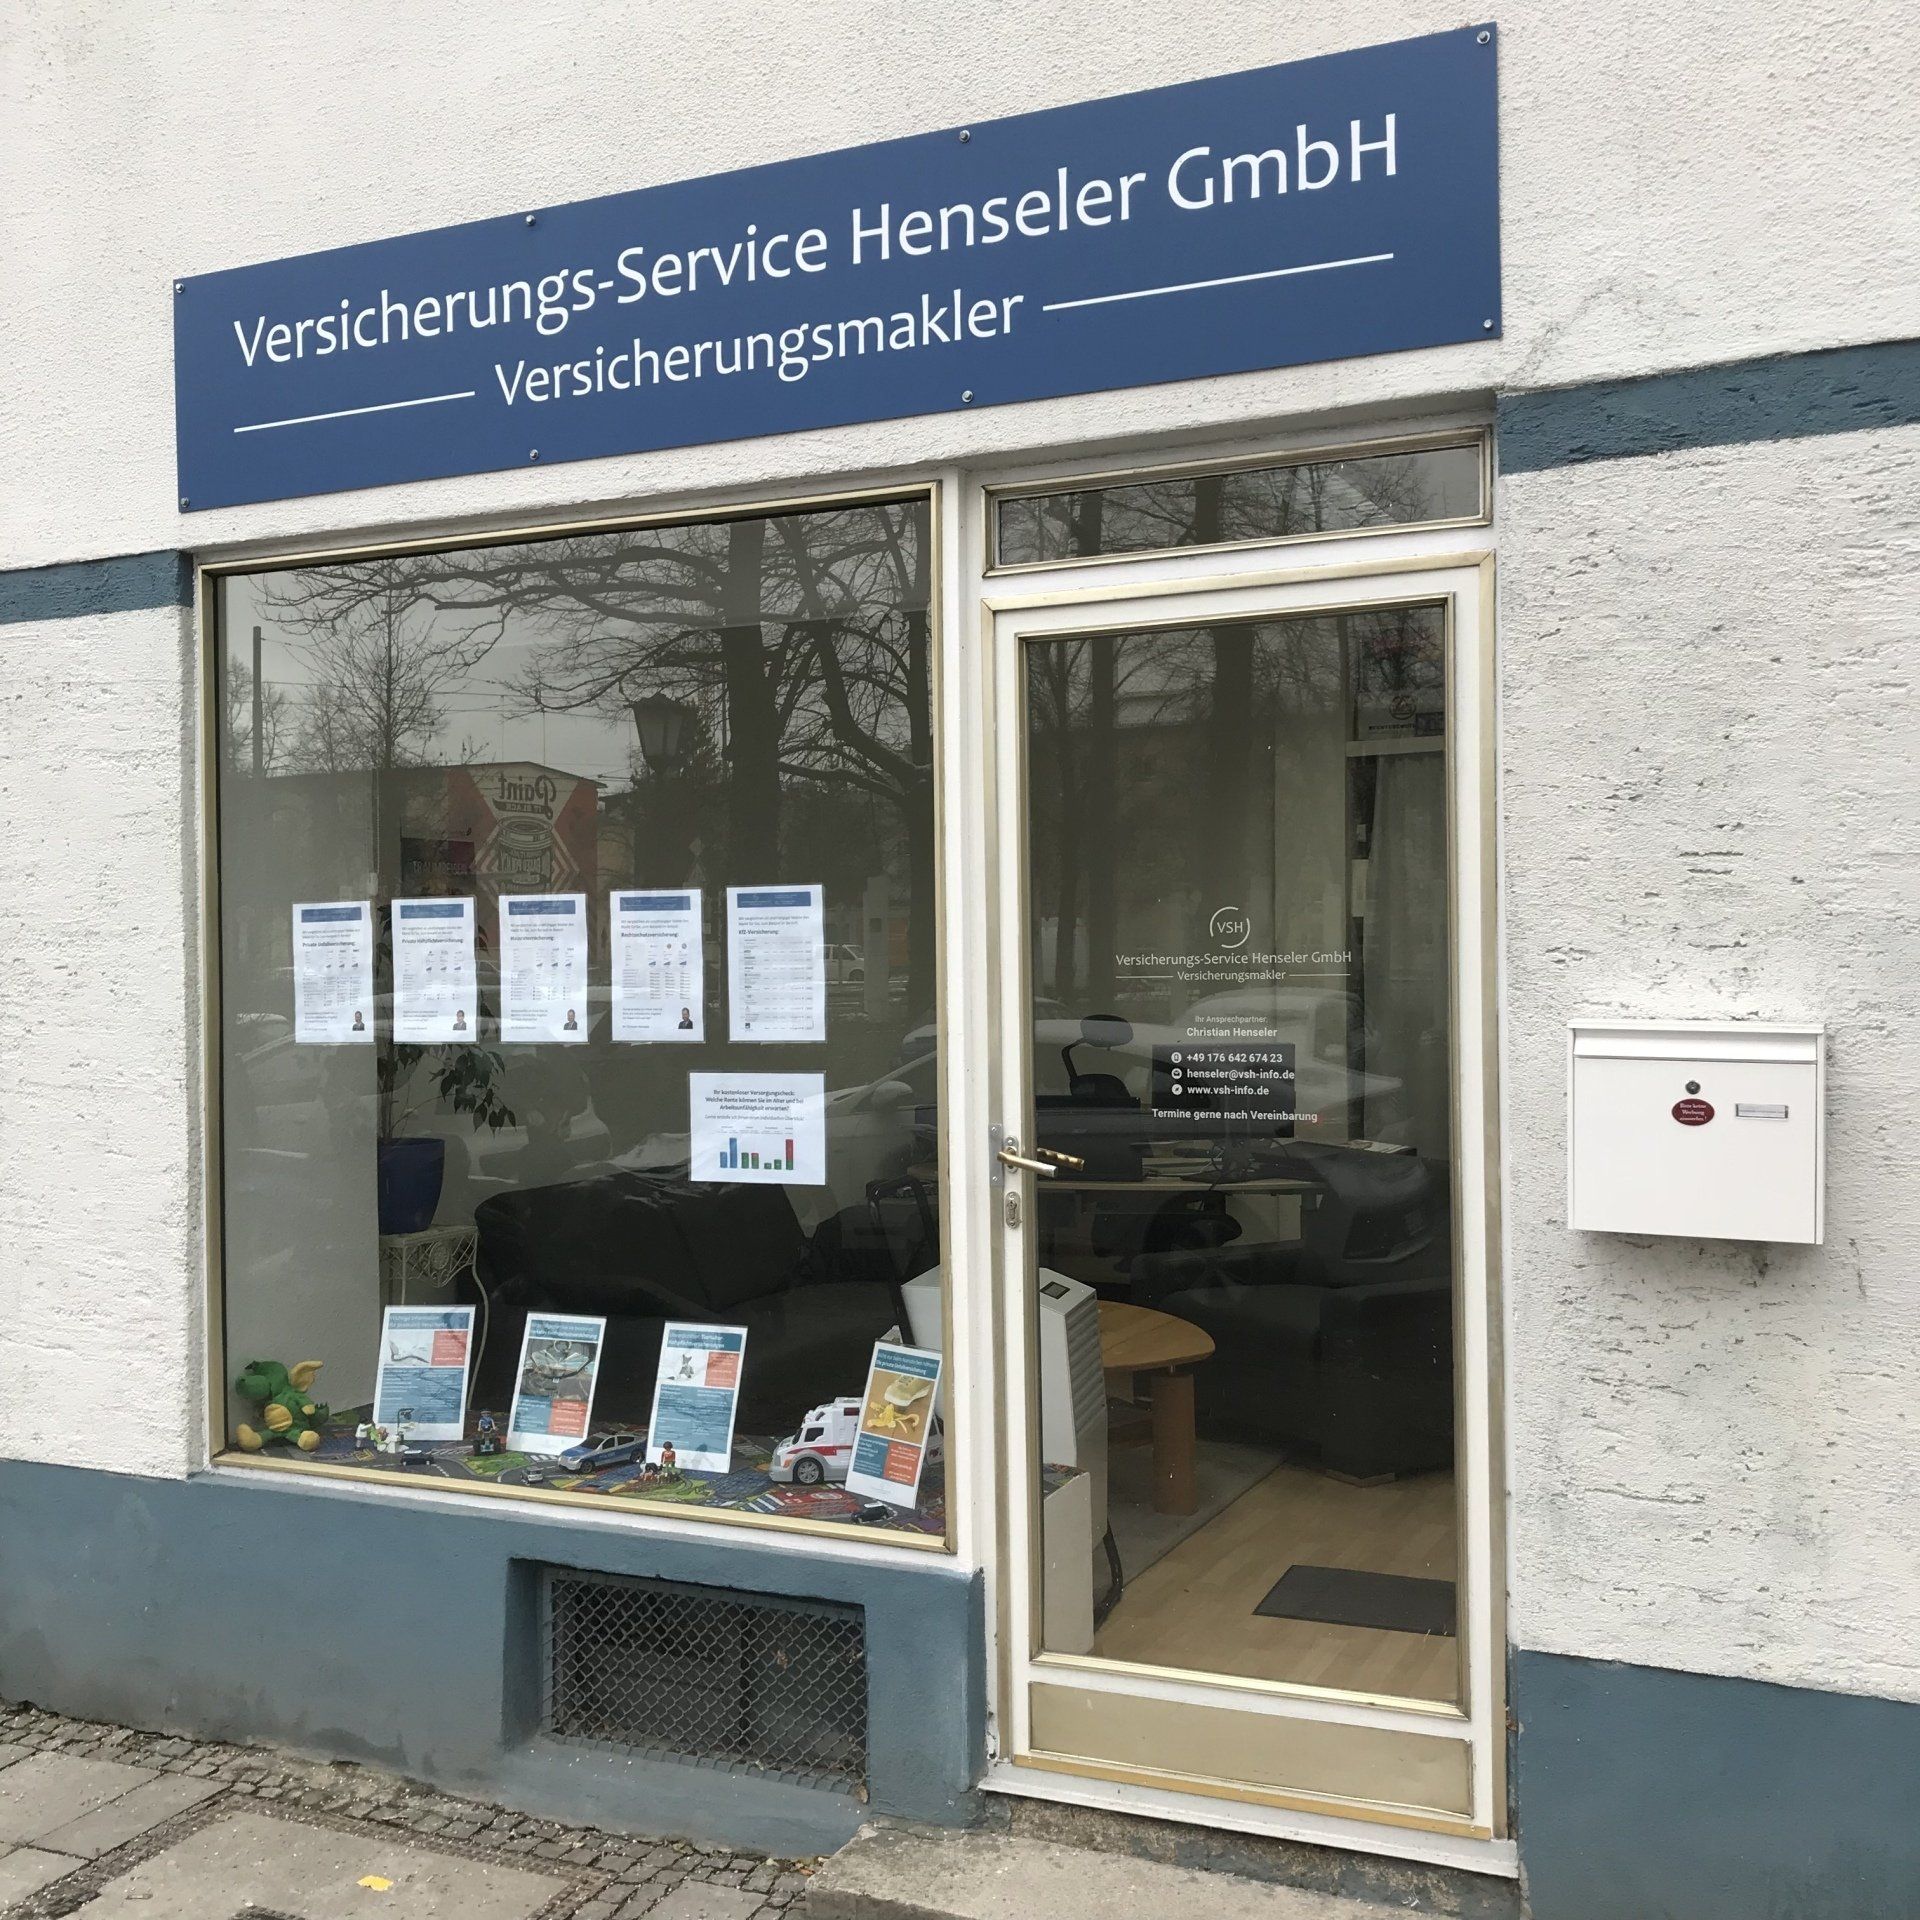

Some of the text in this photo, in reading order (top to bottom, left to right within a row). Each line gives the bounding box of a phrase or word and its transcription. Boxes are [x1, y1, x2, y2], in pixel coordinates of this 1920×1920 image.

[233, 114, 1397, 367] Versicherungs-Service Henseler GmbH
[494, 288, 1025, 406] Versicherungsmakler
[1217, 921, 1243, 934] VSH
[1115, 950, 1352, 968] Versicherungs-Service Henseler GmbH
[1177, 969, 1286, 983] Versicherungsmakler
[1186, 1027, 1278, 1037] Christian Henseler
[1186, 1053, 1283, 1063] +49 176 642 674 23
[1186, 1068, 1295, 1080] henseler@vsh-info.de
[1187, 1085, 1270, 1096] www.vsh-info.de
[1151, 1108, 1318, 1123] Termine gerne nach Vereinbarung
